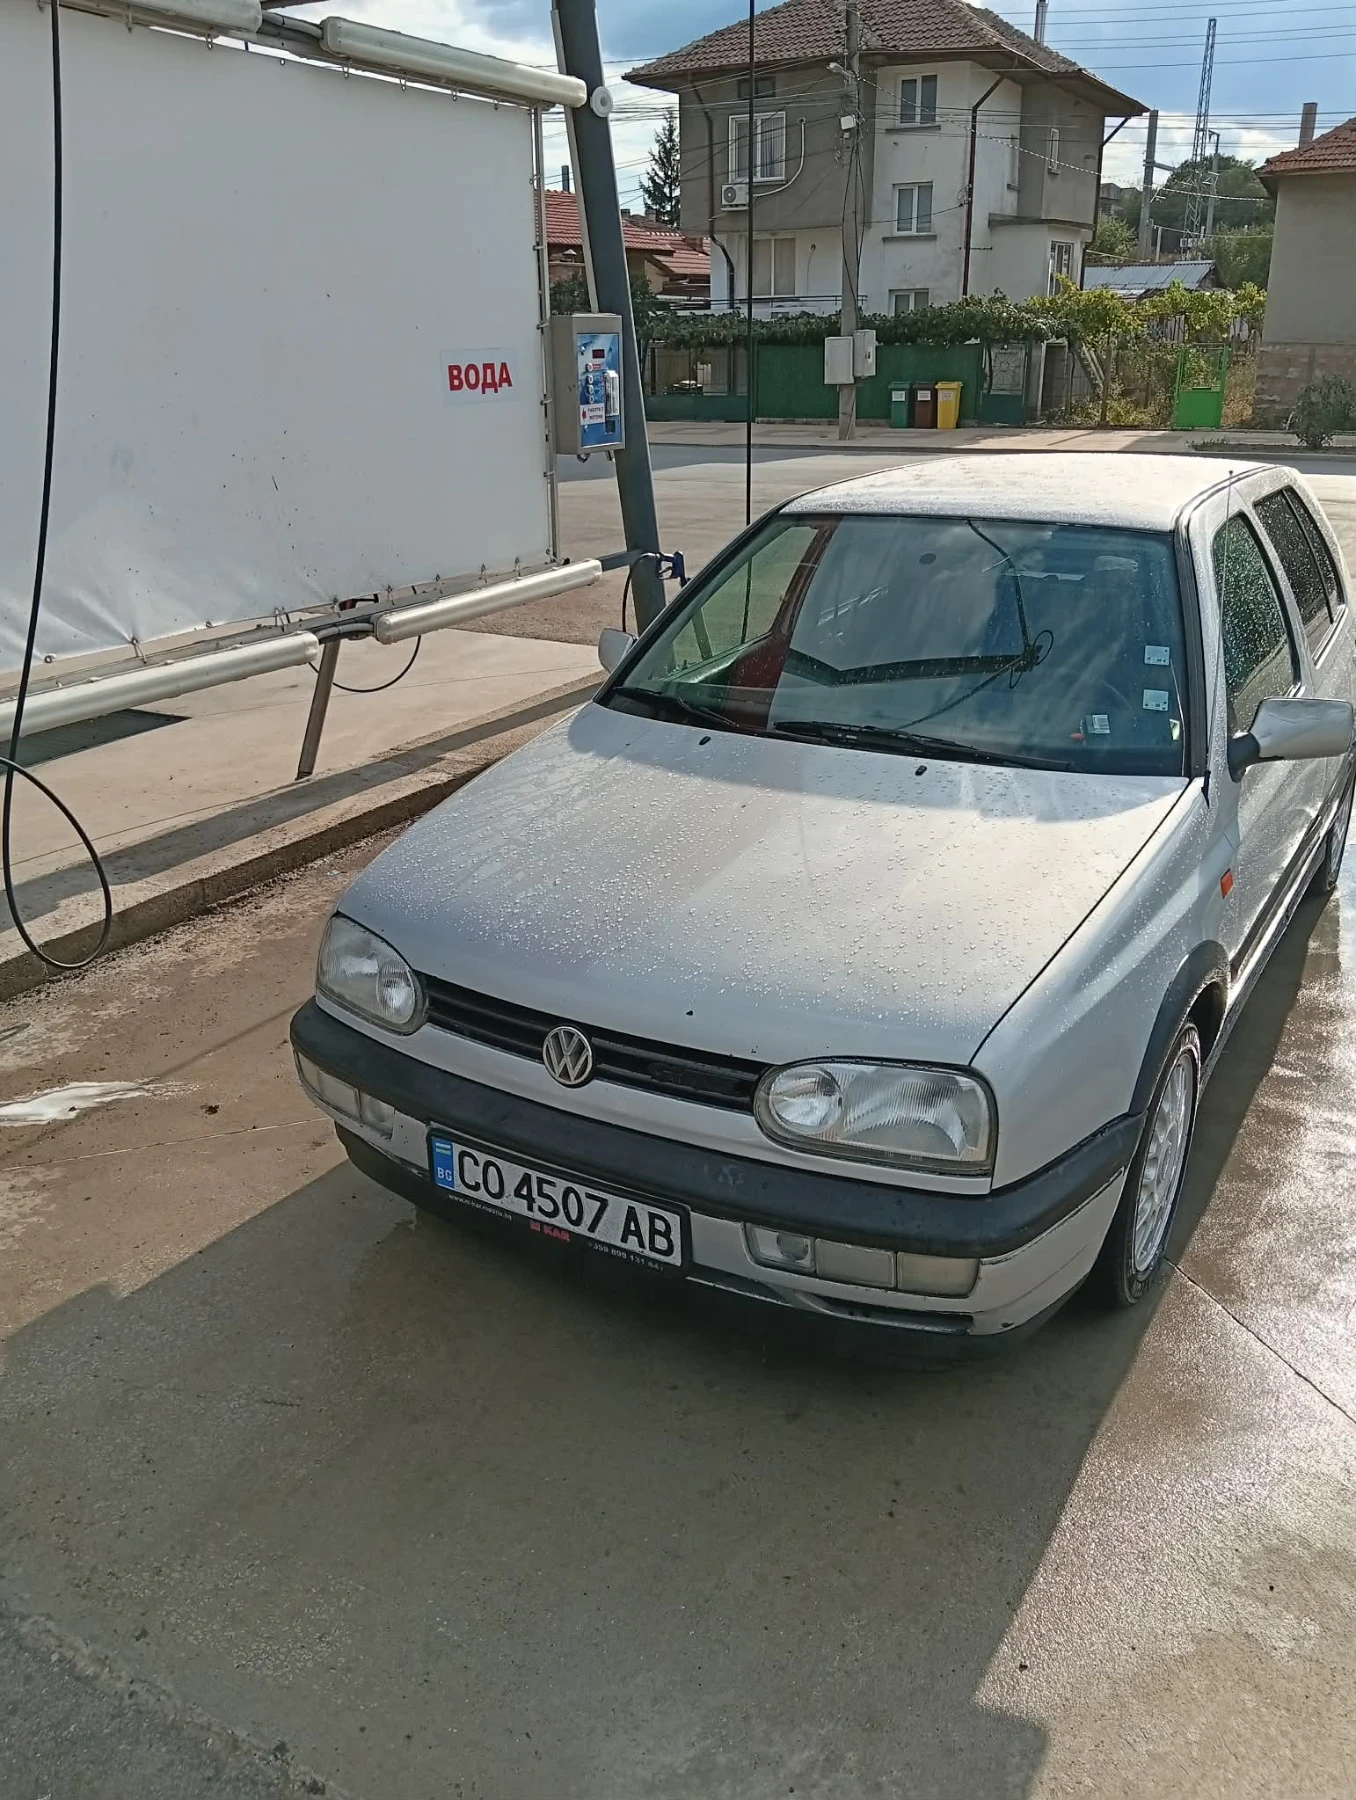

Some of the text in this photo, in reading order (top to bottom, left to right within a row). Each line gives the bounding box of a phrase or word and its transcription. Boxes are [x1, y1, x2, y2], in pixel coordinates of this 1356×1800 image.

[448, 362, 513, 394] ВОДА
[543, 1026, 593, 1085] VW
[437, 1167, 453, 1182] BG
[458, 1150, 675, 1257] CO 4507 AB
